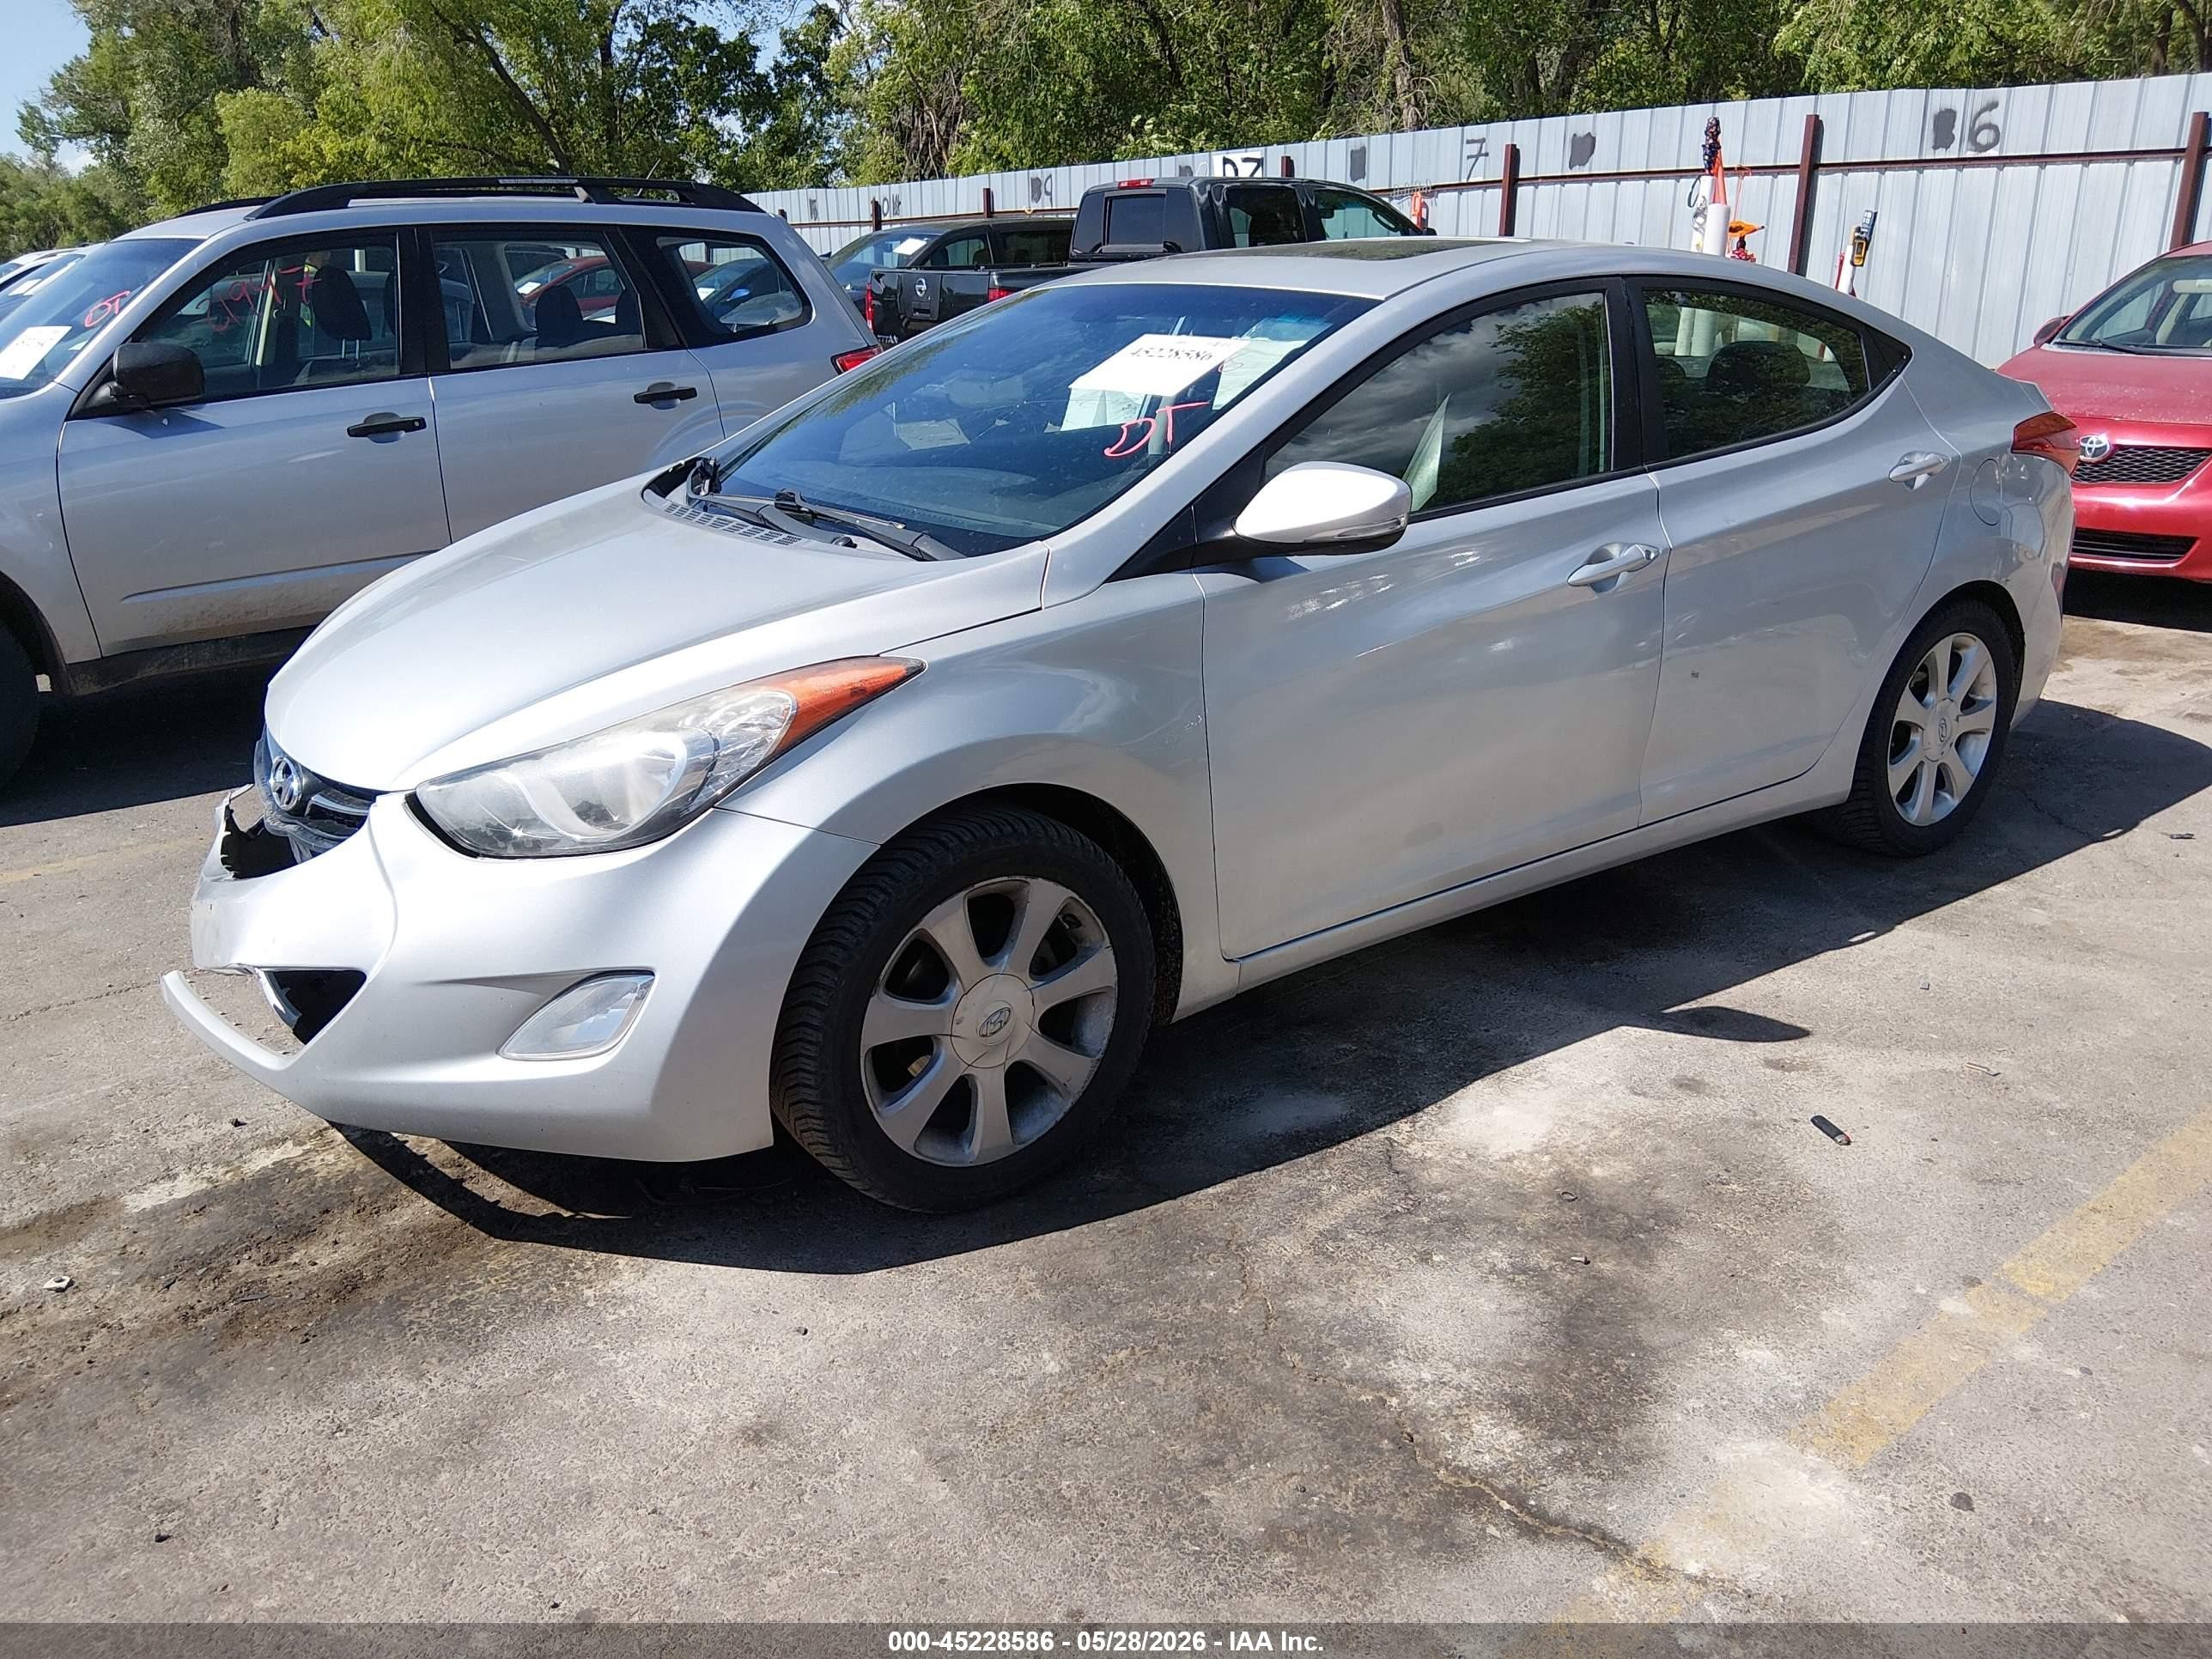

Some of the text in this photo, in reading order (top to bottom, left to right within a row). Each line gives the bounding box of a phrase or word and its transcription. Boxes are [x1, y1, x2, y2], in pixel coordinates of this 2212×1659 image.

[1222, 155, 1265, 179] D7
[1466, 137, 1489, 182] 7
[1103, 401, 1210, 457] DT
